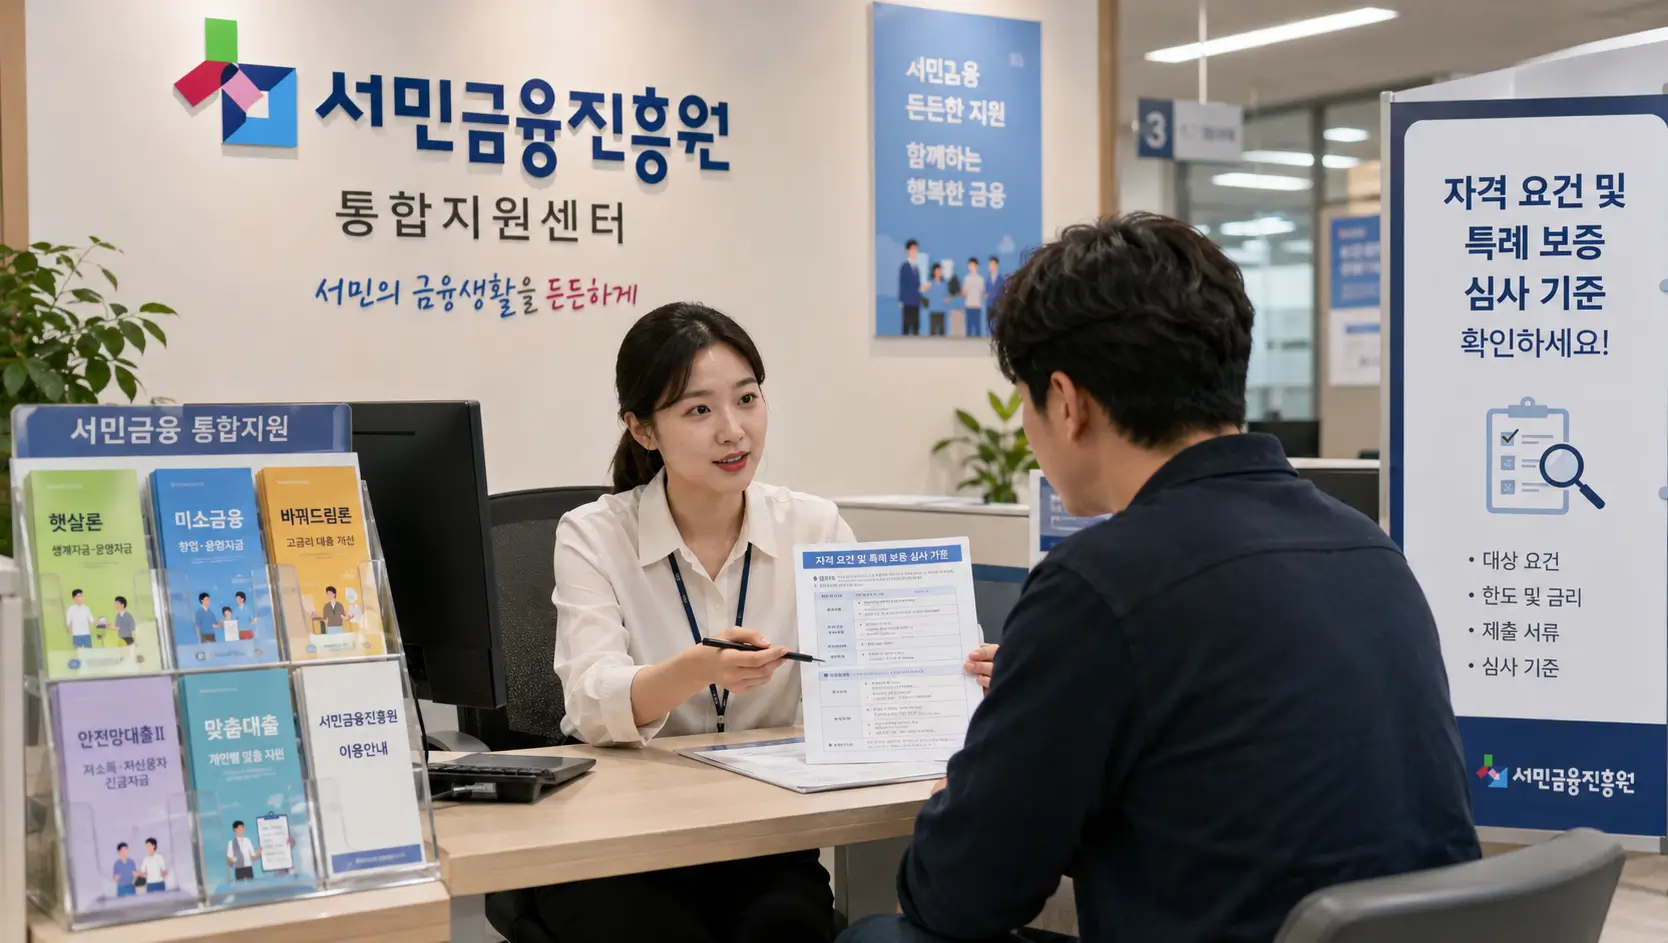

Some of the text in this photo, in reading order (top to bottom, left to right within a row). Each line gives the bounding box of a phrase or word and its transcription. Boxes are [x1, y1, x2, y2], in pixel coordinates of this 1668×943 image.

[906, 56, 980, 88] 서민금융
[906, 93, 1006, 128] 든든한 지원
[316, 71, 730, 184] 서민금융진흥원
[1145, 110, 1167, 149] 3
[906, 141, 982, 172] 함께하는
[907, 177, 1007, 209] 행복한 금융
[1443, 172, 1626, 211] 자격 요건 및
[335, 190, 625, 244] 통합지원센터
[1464, 224, 1606, 261] 특례 보증
[315, 272, 638, 318] 서민의 금융생활을 든든하게
[1464, 274, 1606, 311] 심사 기준
[1460, 326, 1609, 359] 확인하세요!
[70, 415, 288, 445] 서민금융 통합지원
[49, 513, 103, 532] 햇살론
[175, 509, 244, 529] 미소금융
[280, 507, 352, 526] 바꿔드림론
[1482, 551, 1560, 572] 대상 요건
[1482, 585, 1582, 608] 한도 및 금리
[1482, 621, 1560, 643] 제출 서류
[1482, 656, 1560, 678] 심사 기준
[204, 714, 279, 741] 맞춤대출
[319, 709, 398, 728] 서민금융진흥원
[340, 741, 388, 759] 이용안내
[1512, 767, 1635, 798] 서민금융진흥원
